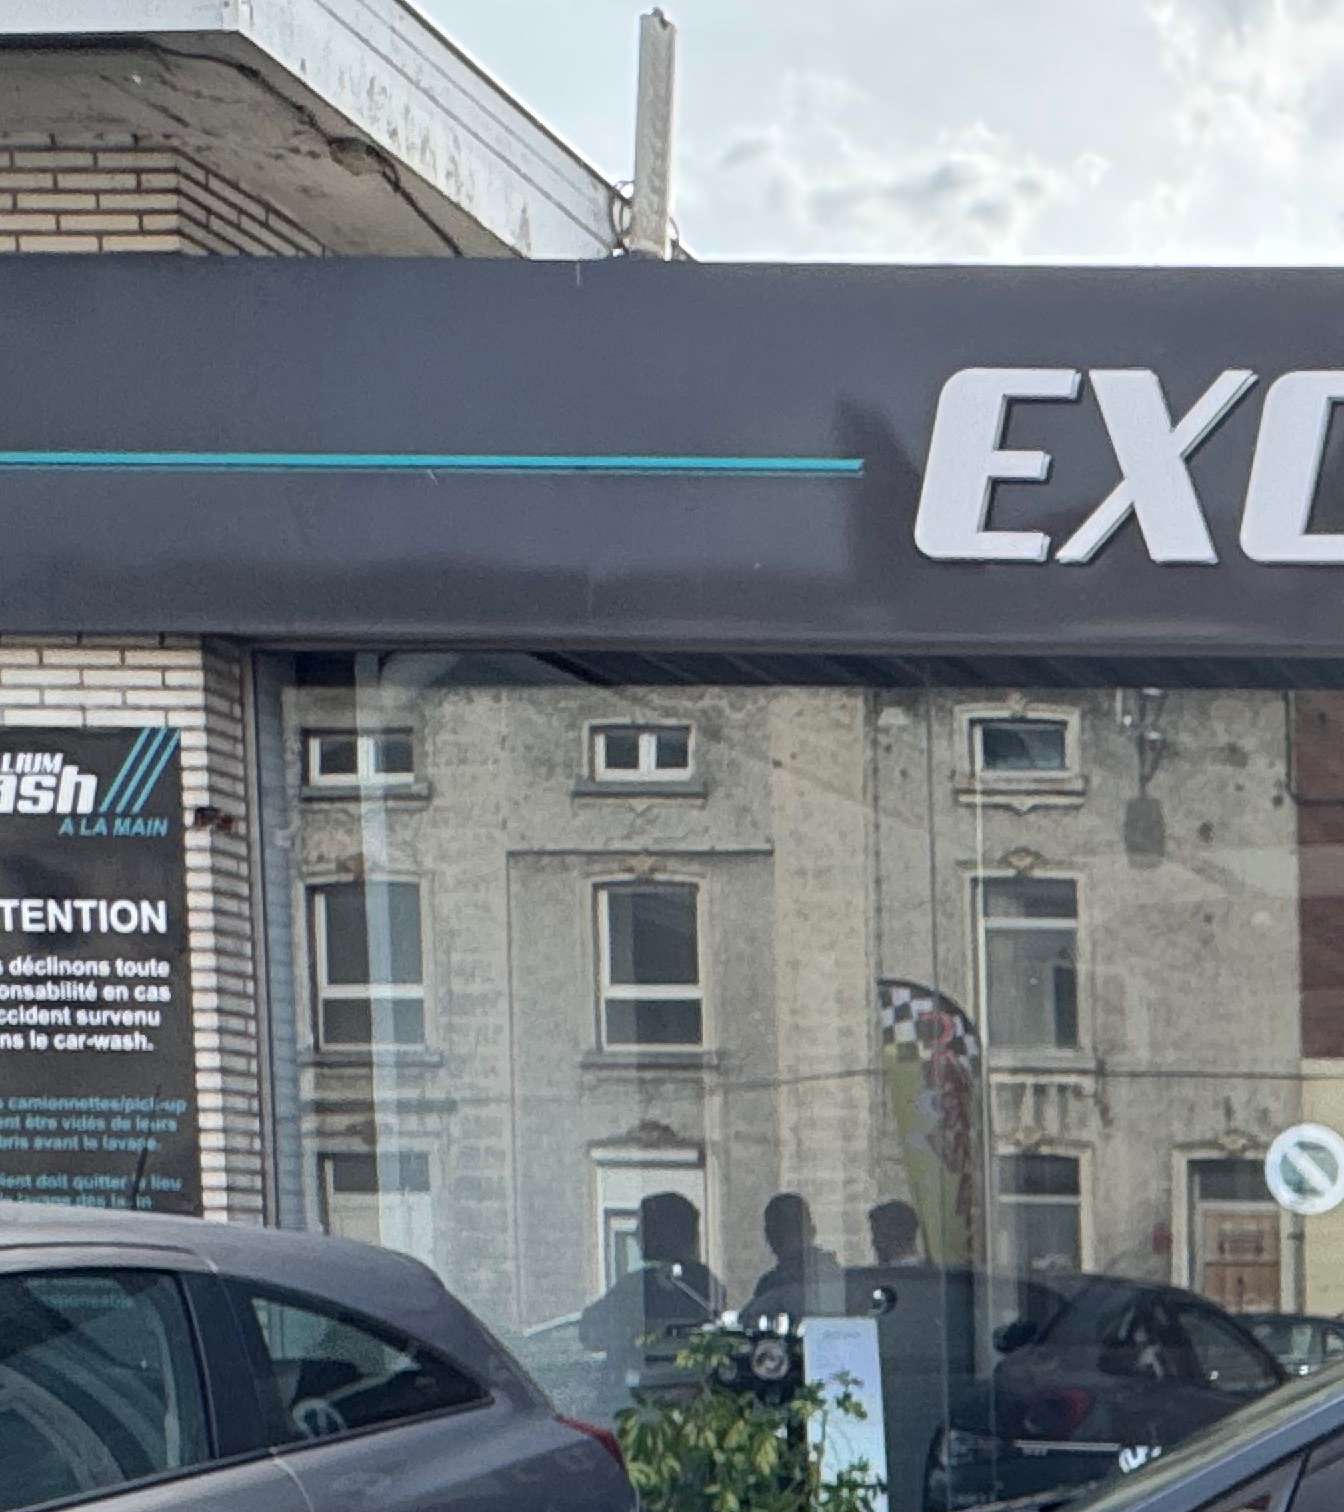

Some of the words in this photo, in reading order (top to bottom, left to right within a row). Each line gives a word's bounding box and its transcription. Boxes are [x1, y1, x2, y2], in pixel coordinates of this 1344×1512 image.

[79, 816, 109, 837] LA
[112, 816, 169, 838] MAIN
[0, 898, 168, 934] TENTION
[8, 955, 112, 977] déclinons
[115, 957, 171, 978] toute
[102, 984, 130, 1002] en
[134, 984, 172, 1002] cas
[76, 1009, 162, 1027] survenu
[29, 1029, 49, 1050] le
[53, 1030, 155, 1052] car-wash.
